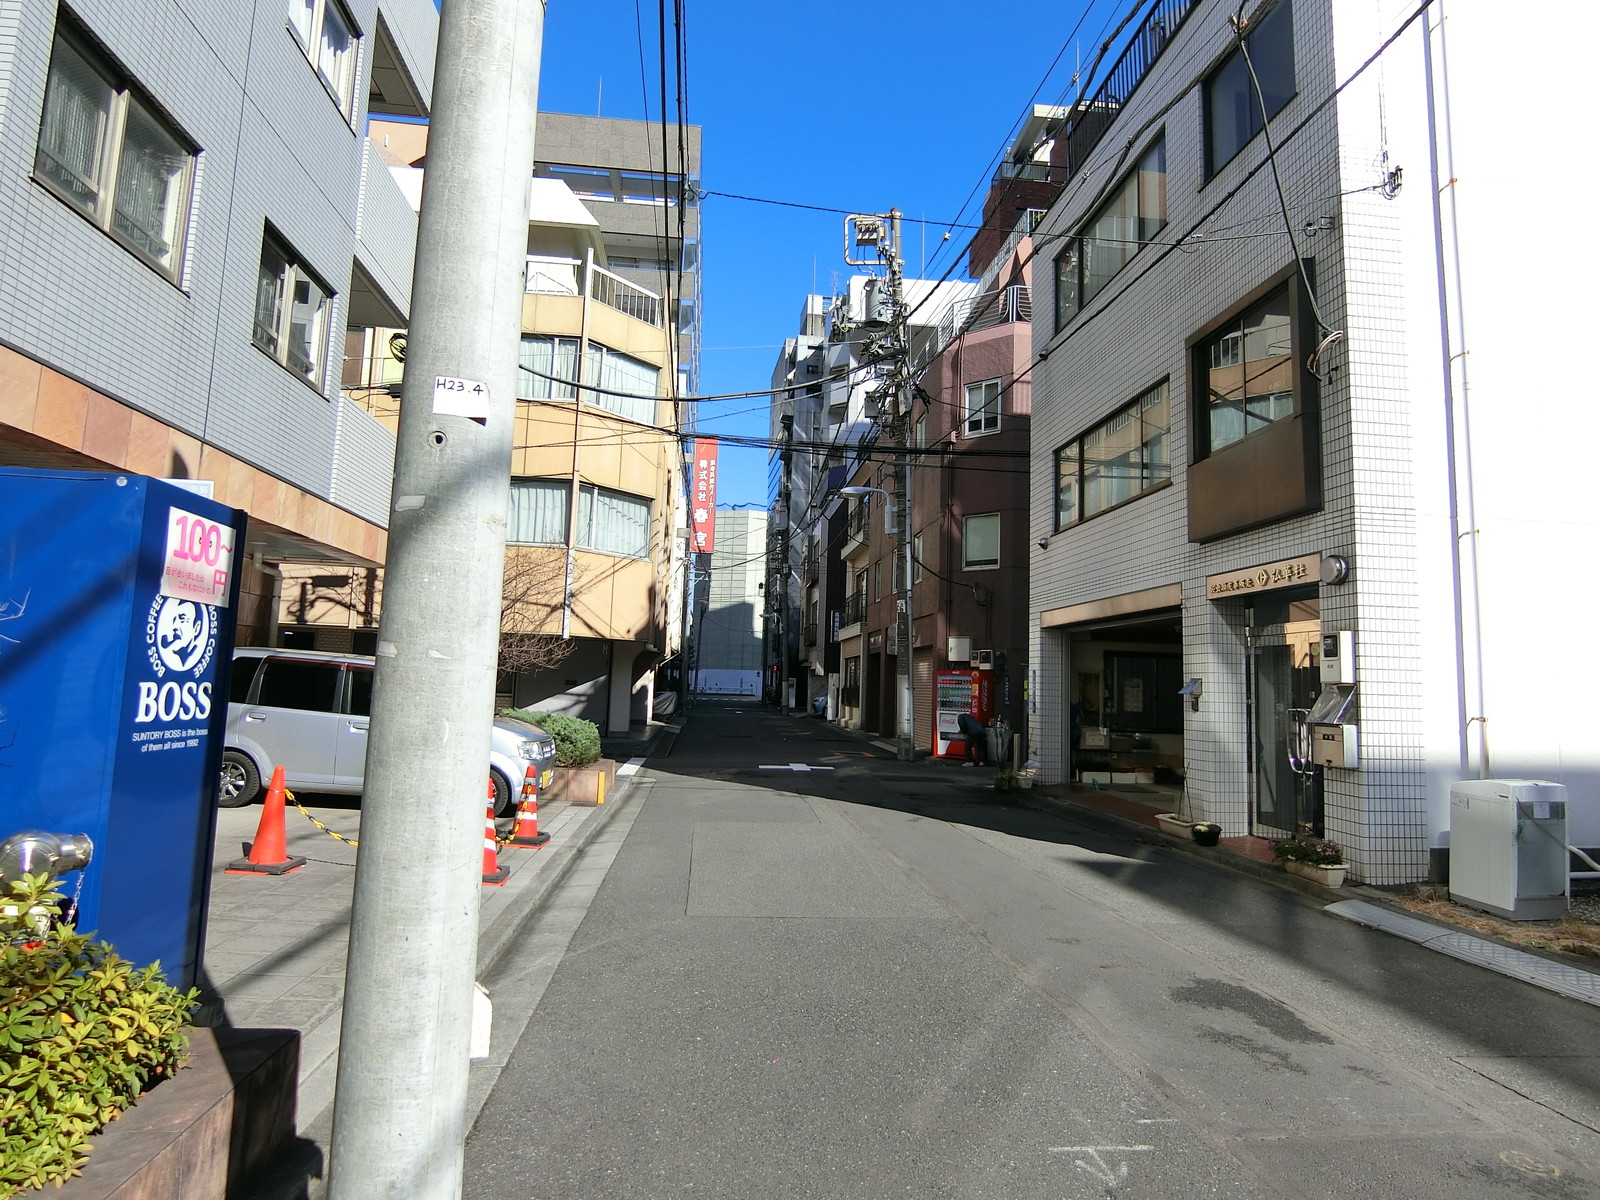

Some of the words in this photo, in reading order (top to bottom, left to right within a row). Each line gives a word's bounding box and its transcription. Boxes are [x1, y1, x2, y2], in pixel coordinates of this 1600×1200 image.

[437, 378, 484, 396] H23.4
[212, 569, 229, 597] 円
[146, 593, 164, 644] COFFEE
[148, 646, 166, 678] BOSS
[193, 638, 216, 679] COFFEE
[134, 681, 212, 723] BOSS
[132, 731, 164, 742] SUNTORY
[164, 729, 182, 739] BOSS
[182, 729, 186, 737] is
[196, 728, 208, 736] boss
[141, 744, 149, 752] of
[148, 742, 162, 751] them
[171, 740, 186, 749] since
[186, 738, 200, 747] 1992
